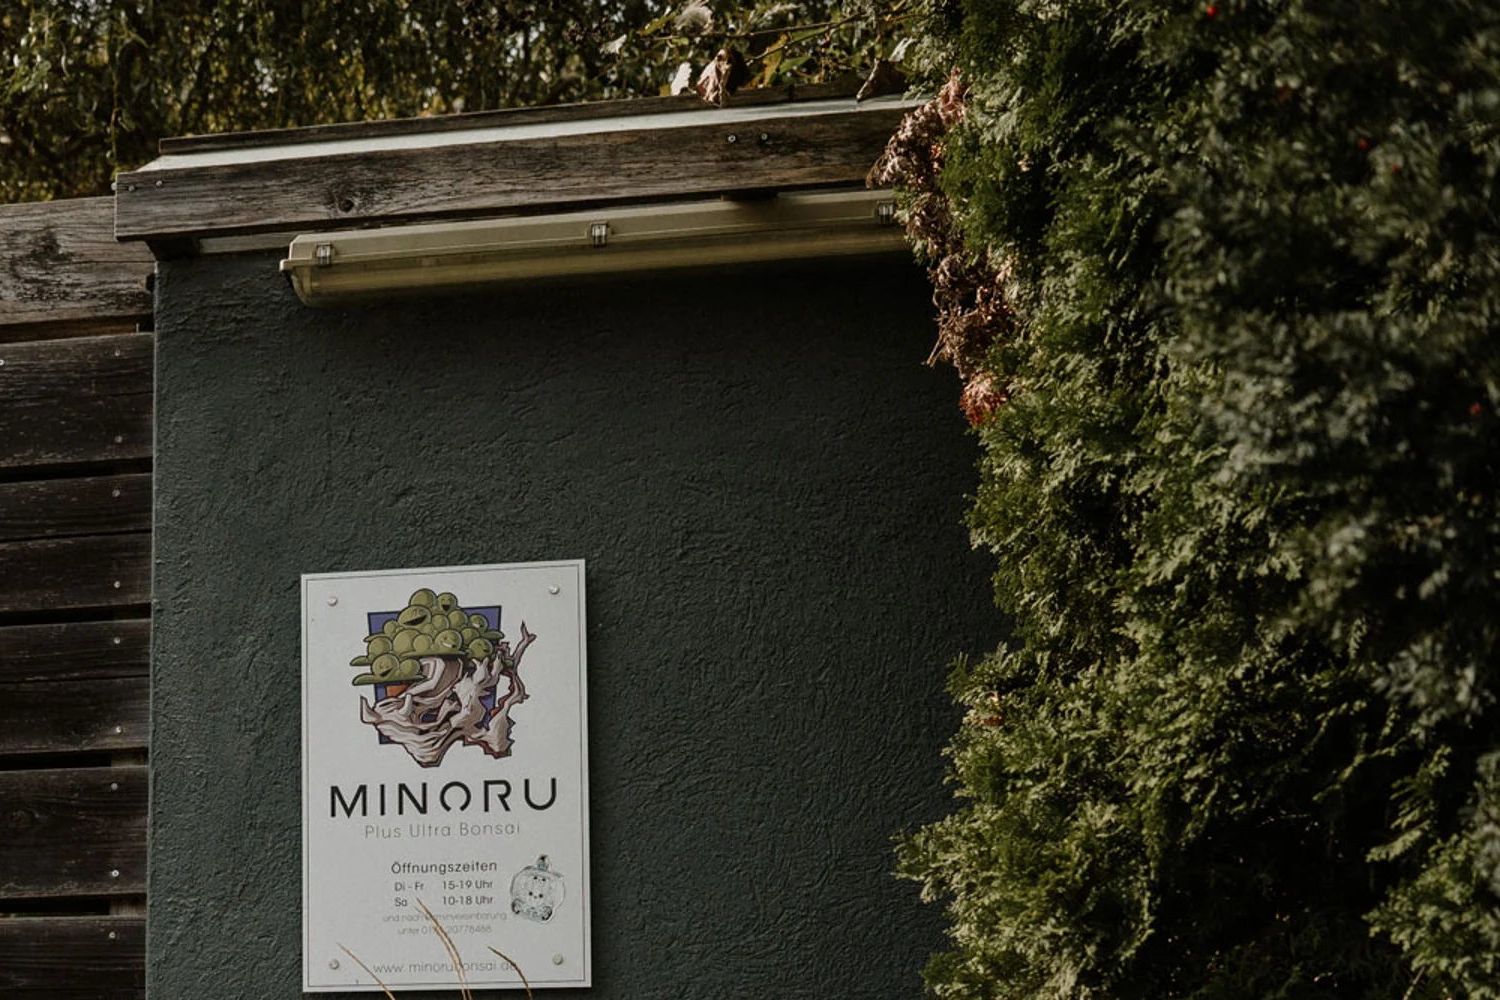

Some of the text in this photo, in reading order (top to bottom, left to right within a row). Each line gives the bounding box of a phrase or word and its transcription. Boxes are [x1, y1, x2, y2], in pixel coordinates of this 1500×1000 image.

[330, 778, 557, 818] MINORU
[365, 820, 521, 839] Plus Ultra Bonsai
[391, 861, 498, 876] Öffnungszeiten
[394, 881, 406, 892] Di
[414, 881, 425, 891] Fr
[442, 880, 473, 890] 15-19
[475, 880, 494, 890] Uhr
[394, 896, 494, 908] Sa 10-18 Uhr
